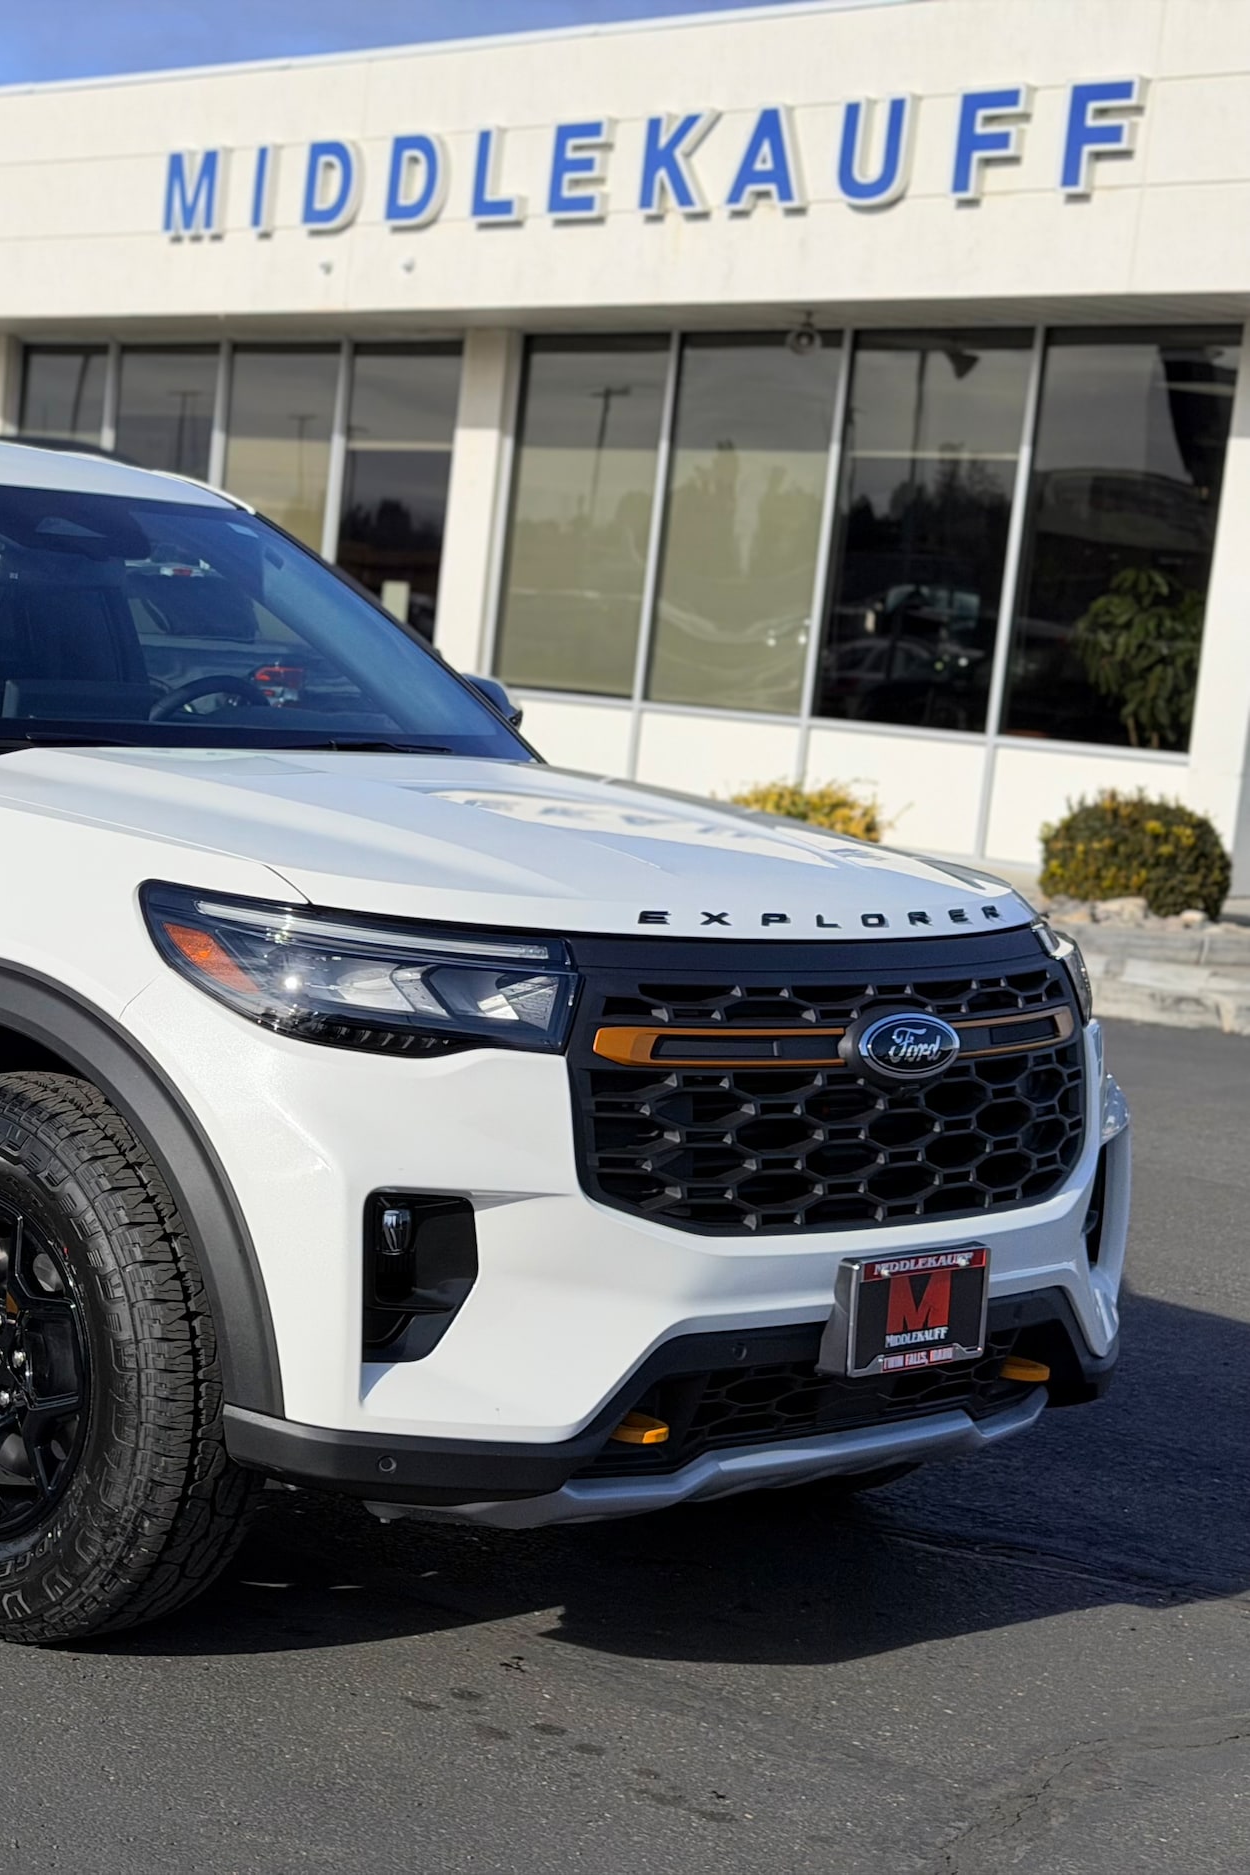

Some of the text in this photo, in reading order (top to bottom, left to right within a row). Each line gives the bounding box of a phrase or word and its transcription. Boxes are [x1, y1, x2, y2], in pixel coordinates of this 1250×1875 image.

[162, 75, 1146, 243] MIDDLEKAUFF
[637, 904, 1004, 929] EXPLORER
[887, 1026, 942, 1064] Ford
[887, 1270, 952, 1334] M
[884, 1326, 949, 1349] MIDDLEKAUFF
